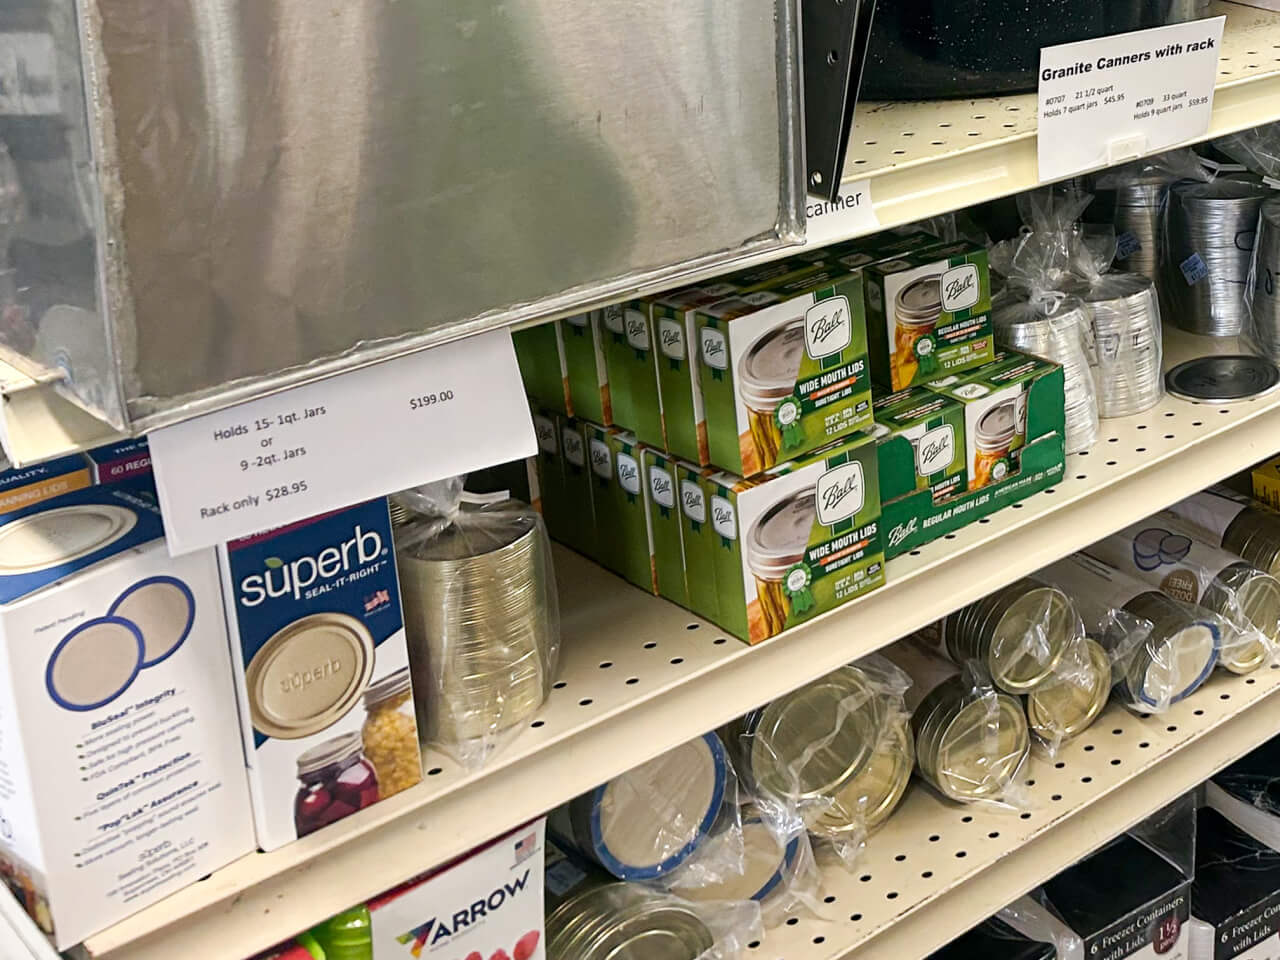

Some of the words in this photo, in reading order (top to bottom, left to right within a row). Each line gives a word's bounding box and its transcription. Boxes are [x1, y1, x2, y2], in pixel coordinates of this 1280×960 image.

[1042, 63, 1092, 81] Granite
[1097, 51, 1150, 70] Canners
[1155, 43, 1182, 58] with
[1186, 38, 1215, 53] rack
[1045, 95, 1065, 106] #0707
[1075, 91, 1082, 99] 21
[1085, 88, 1095, 97] 1/2
[1097, 85, 1113, 96] quart
[806, 193, 862, 218] canner
[946, 274, 974, 299] Ball
[811, 309, 846, 342] Ball
[799, 379, 819, 395] WIDE
[821, 368, 847, 386] MOUTH
[848, 360, 864, 374] LIDS
[410, 390, 454, 410] $199.00
[214, 424, 248, 441] Holds
[255, 418, 274, 432] 15-
[277, 411, 301, 428] 1qt.
[303, 404, 326, 419] Jars
[240, 460, 248, 471] 9
[251, 451, 281, 467] -2qt.
[284, 446, 307, 460] Jars
[261, 437, 273, 448] or
[200, 502, 229, 519] Rack
[233, 495, 260, 514] only
[265, 480, 308, 502] $28.95
[888, 517, 918, 547] Ball
[923, 509, 952, 528] REGULAR
[953, 500, 975, 517] MOUTH
[976, 494, 989, 507] LIDS
[809, 544, 830, 561] WIDE
[831, 531, 858, 552] MOUTH
[860, 523, 877, 539] LIDS
[431, 870, 531, 945] ARROW
[1091, 942, 1098, 954] 6
[1102, 923, 1134, 949] Freezer
[1136, 895, 1185, 929] Containers
[1103, 945, 1123, 960] with
[1126, 936, 1145, 952] Lids
